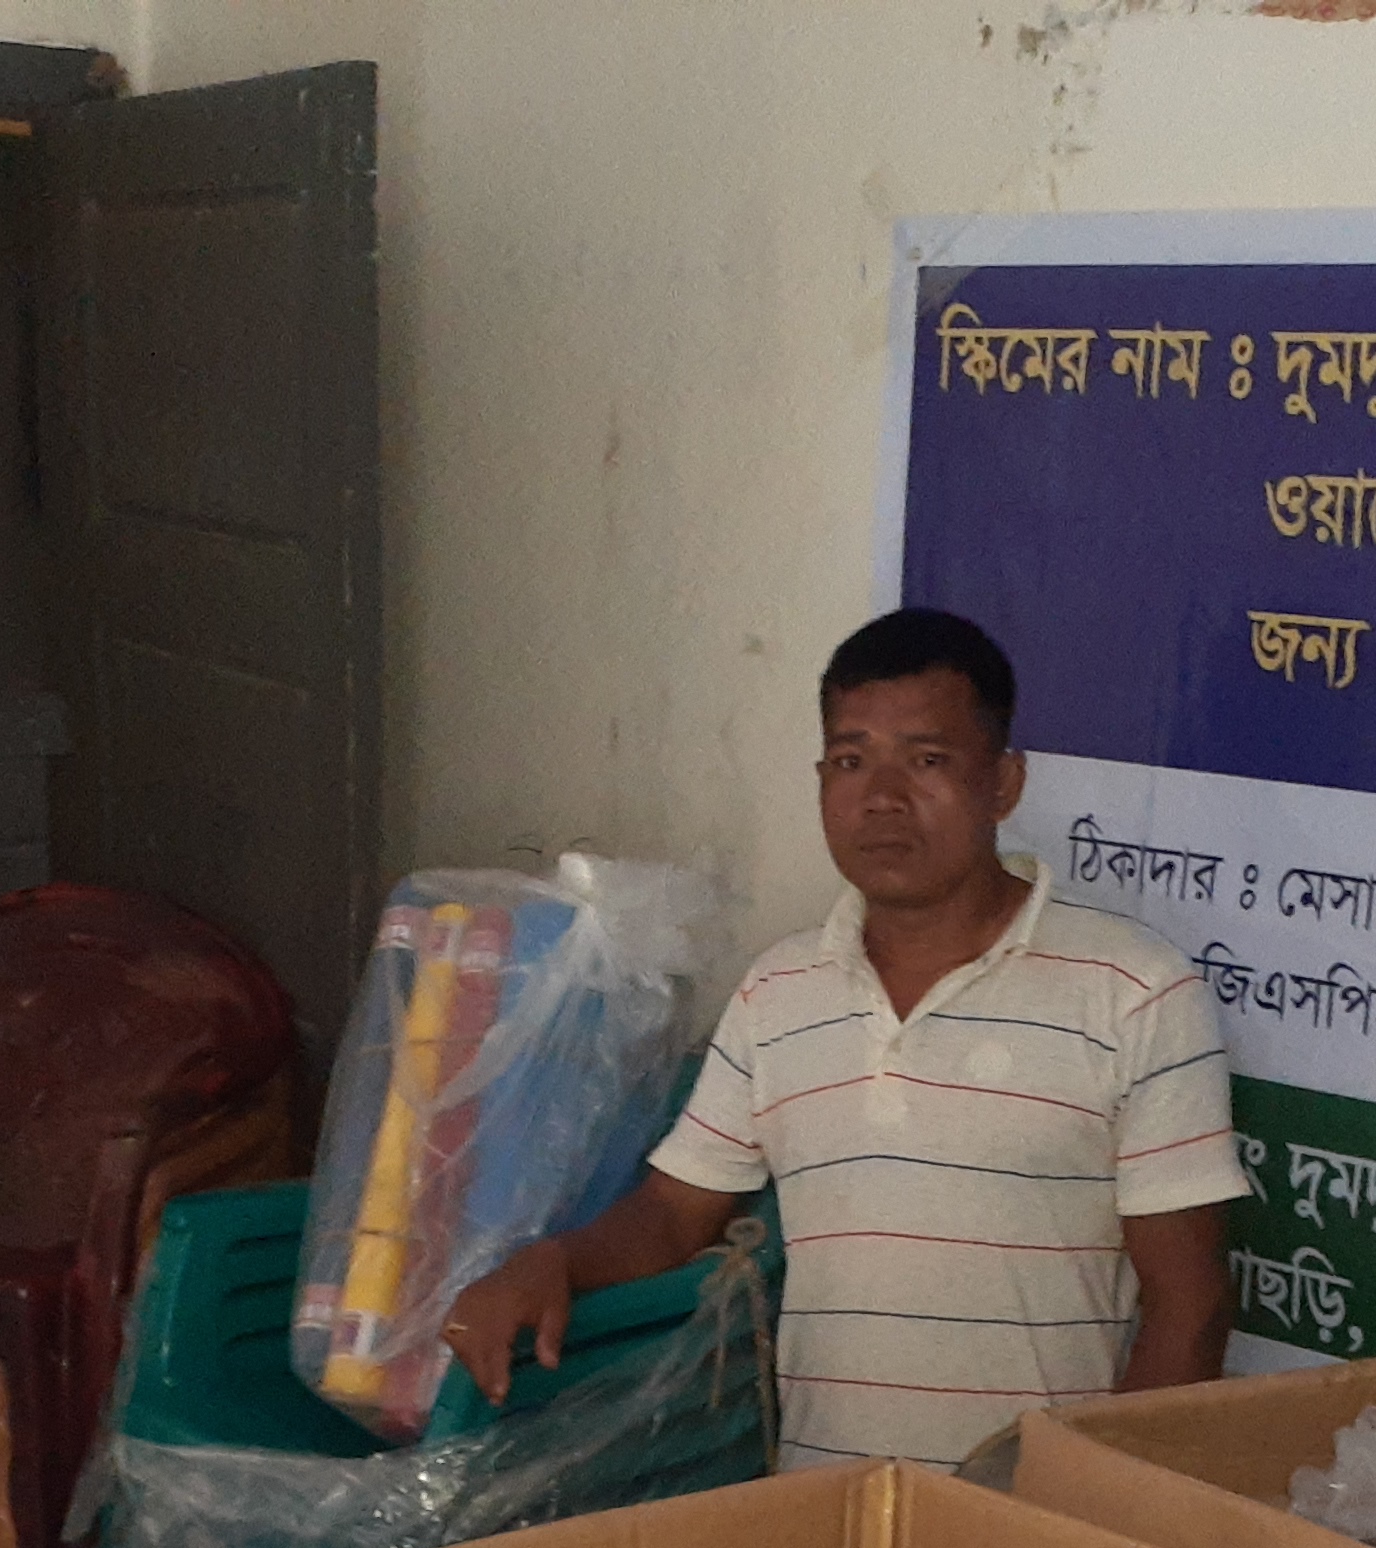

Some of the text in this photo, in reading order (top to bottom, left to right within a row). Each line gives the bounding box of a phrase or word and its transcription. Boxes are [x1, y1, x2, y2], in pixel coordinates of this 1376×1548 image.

[936, 304, 1096, 396] স্কিমের
[1109, 319, 1211, 400] নাম
[1247, 609, 1370, 691] জন্য
[1067, 813, 1226, 904] ঠিকাদার
[1229, 1245, 1365, 1353] াছড়ি,
